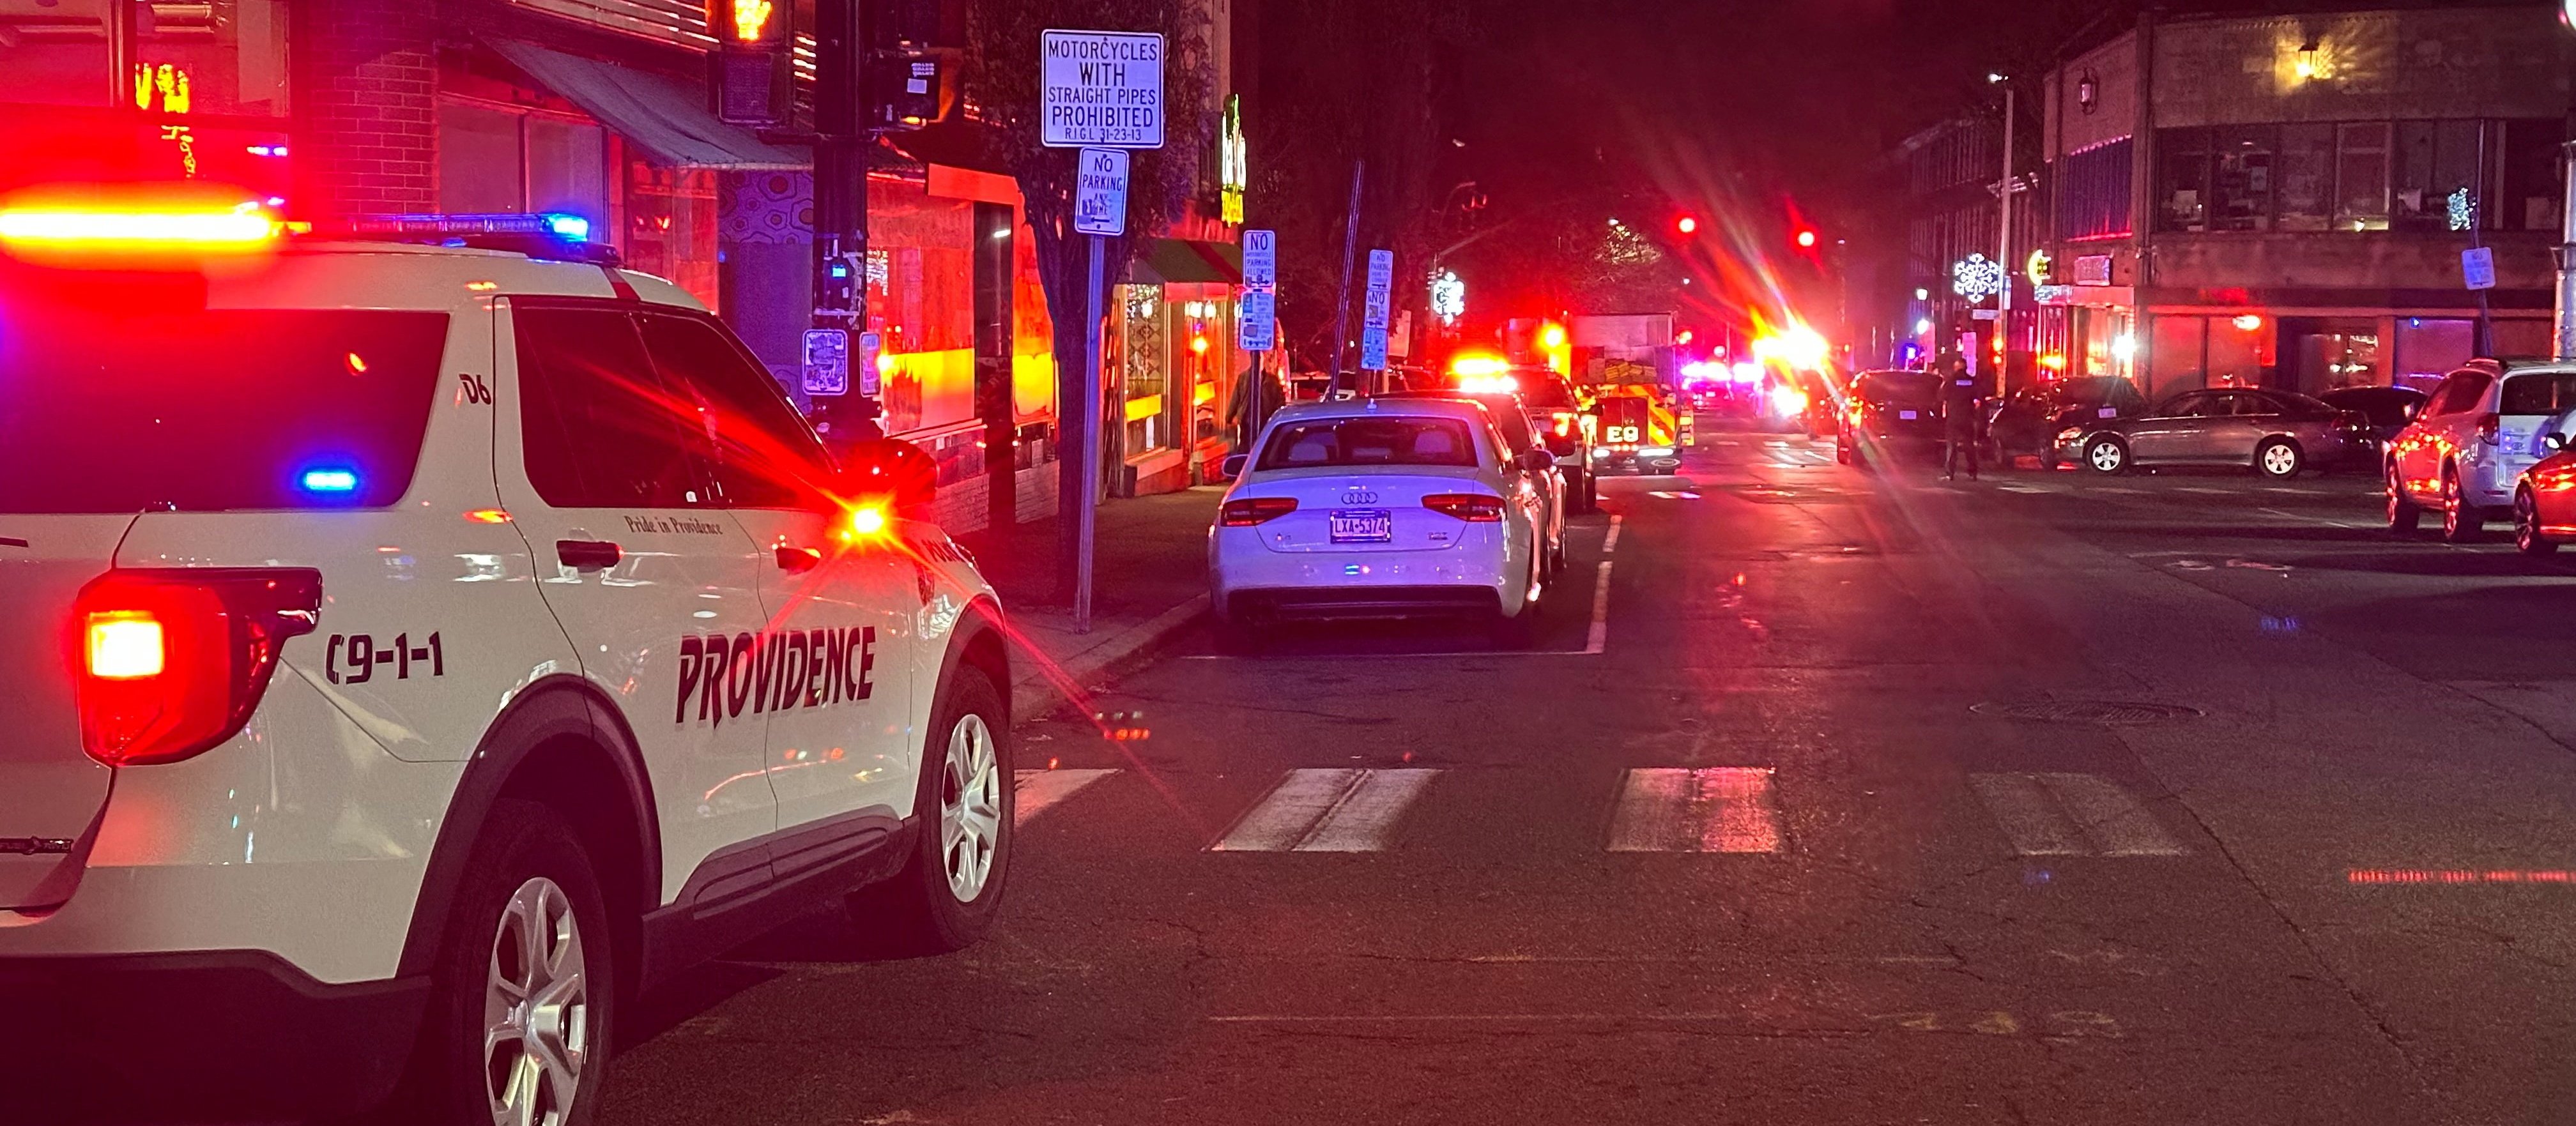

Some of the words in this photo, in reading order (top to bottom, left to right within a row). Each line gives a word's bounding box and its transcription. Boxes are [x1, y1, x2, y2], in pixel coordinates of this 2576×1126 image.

[1048, 40, 1158, 61] MOTORCYCLES
[1079, 62, 1126, 87] WITH
[1048, 86, 1111, 104] STRAIGHT
[1118, 89, 1156, 105] PIPES
[1052, 106, 1154, 128] PROHIBITED
[1100, 128, 1142, 141] 31-23-13
[1094, 157, 1113, 172] NO
[1082, 174, 1123, 192] PARKING
[1250, 233, 1268, 250] NO
[1246, 259, 1271, 267] PARKING
[1376, 254, 1386, 262] NO
[1371, 291, 1385, 305] NO
[459, 374, 491, 405] D6
[624, 515, 657, 533] Pride
[655, 517, 671, 533] in
[669, 517, 723, 535] Providence
[346, 631, 443, 685] 9-1-1
[675, 625, 877, 730] PROVIDENCE
